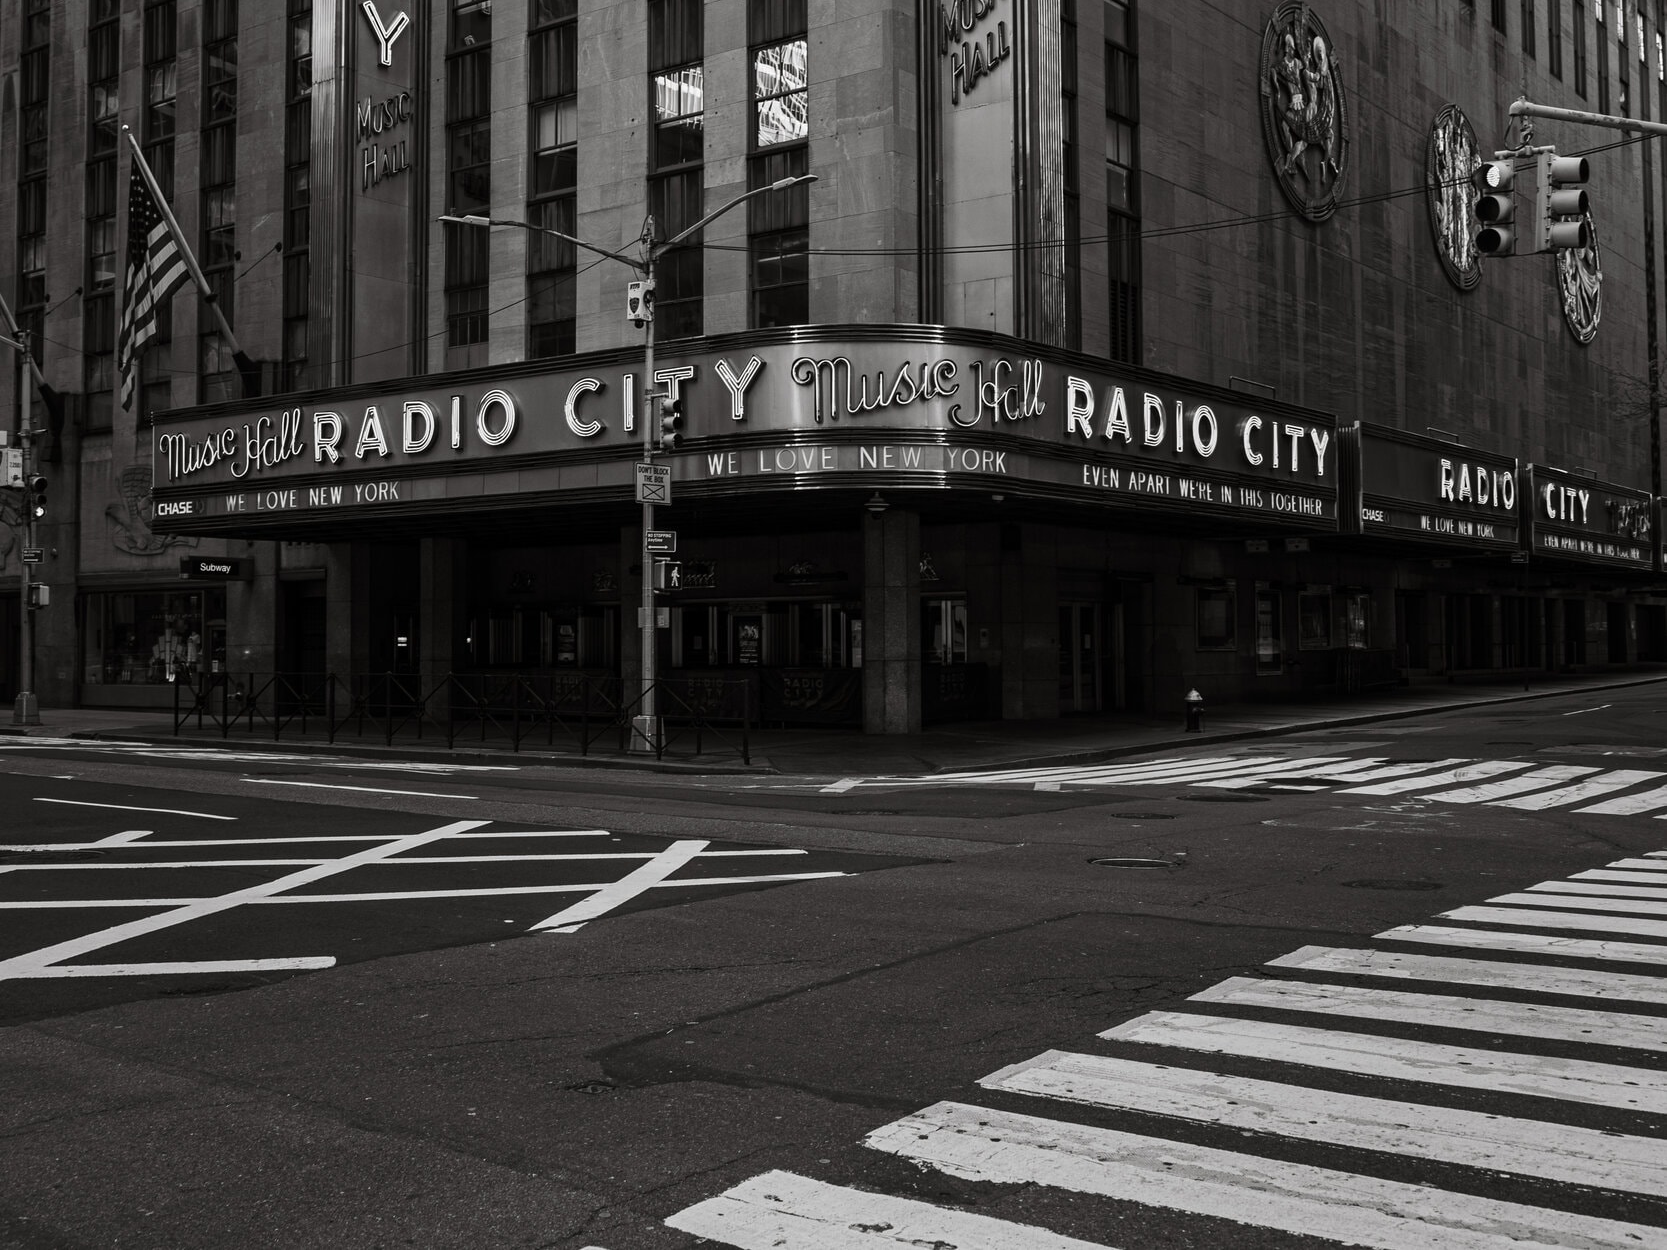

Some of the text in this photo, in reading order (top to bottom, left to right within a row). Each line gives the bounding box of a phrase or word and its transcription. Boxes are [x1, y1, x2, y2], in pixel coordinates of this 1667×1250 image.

[951, 21, 1010, 105] HALL
[363, 141, 410, 191] HALL
[314, 355, 764, 463] RADIO CITY
[791, 357, 1046, 426] Music Hall
[159, 408, 304, 481] Music Hall
[1067, 376, 1330, 476] RADIO CITY
[638, 466, 669, 475] DON'T BLOCK
[707, 446, 1006, 475] WE LOVE NEW YORK
[158, 502, 193, 515] CHASE
[226, 481, 399, 512] WE LOVE NEW YORK
[1084, 464, 1322, 515] EVEN APART WE'RE IN THIS TOGETHER
[1440, 458, 1515, 509] RADIO
[1545, 482, 1590, 524] CITY
[1362, 508, 1384, 522] CHASE
[1421, 515, 1494, 538] WE LOVE NEW YORK
[200, 563, 231, 575] Subway
